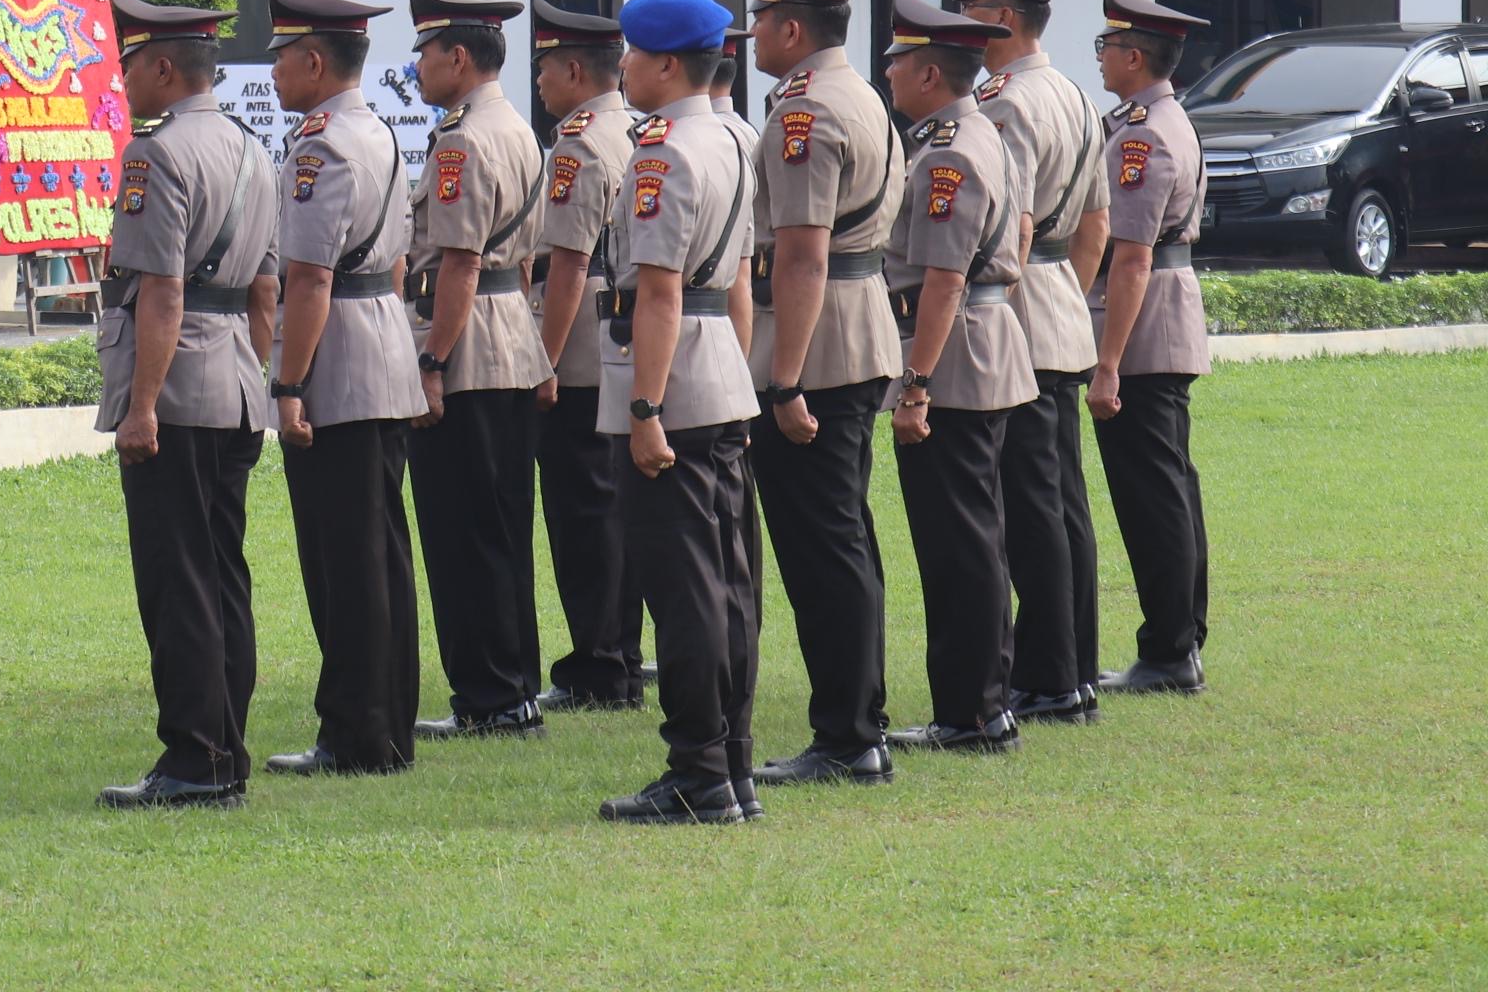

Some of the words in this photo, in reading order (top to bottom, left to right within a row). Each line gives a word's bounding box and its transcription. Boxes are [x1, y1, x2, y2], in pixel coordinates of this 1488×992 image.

[241, 82, 272, 97] ATAS
[1123, 142, 1149, 152] POLDA
[124, 162, 149, 170] POLDA
[555, 157, 579, 169] POLDA
[638, 178, 661, 186] RIAU
